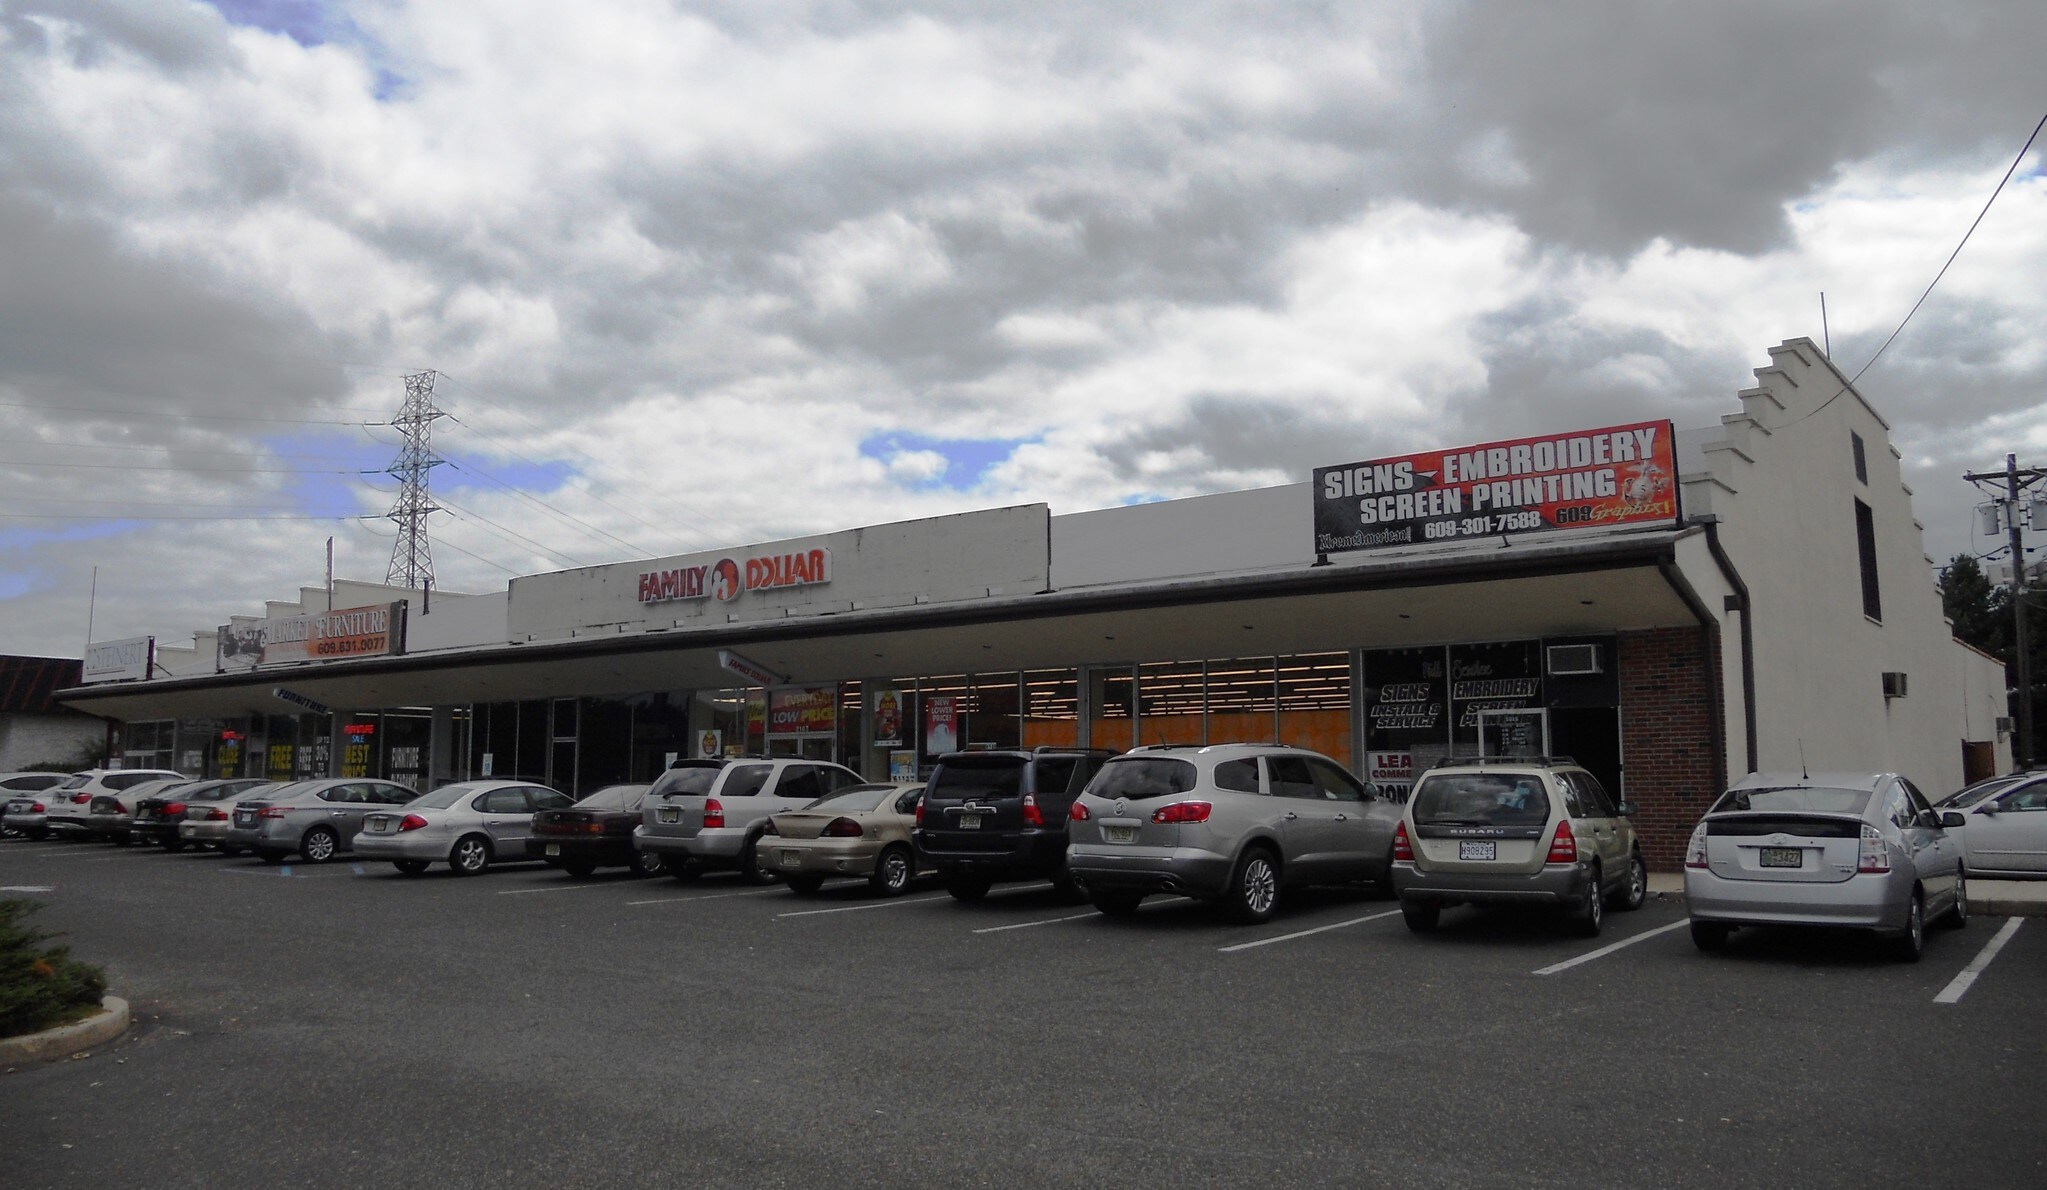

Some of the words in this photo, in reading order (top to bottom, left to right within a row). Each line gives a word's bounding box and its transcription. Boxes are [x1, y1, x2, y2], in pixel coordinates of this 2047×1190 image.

[1324, 461, 1413, 500] SIGNS
[1443, 427, 1656, 485] EMBROIDERY
[1360, 487, 1463, 525] SCREEN
[1472, 468, 1616, 512] PRINTING
[1424, 511, 1541, 540] 609-301-7588
[638, 565, 708, 601] FAMILY
[746, 549, 826, 590] DOLLAR
[315, 609, 387, 640] FURNITURE
[1380, 683, 1431, 704] SIGNS
[1453, 677, 1540, 700] EMBROIDERY
[277, 688, 328, 714] FURNITURE
[931, 706, 953, 714] LOWER
[1370, 703, 1427, 717] INSTALL
[773, 710, 801, 724] LOW
[1376, 715, 1438, 729] SERVICE
